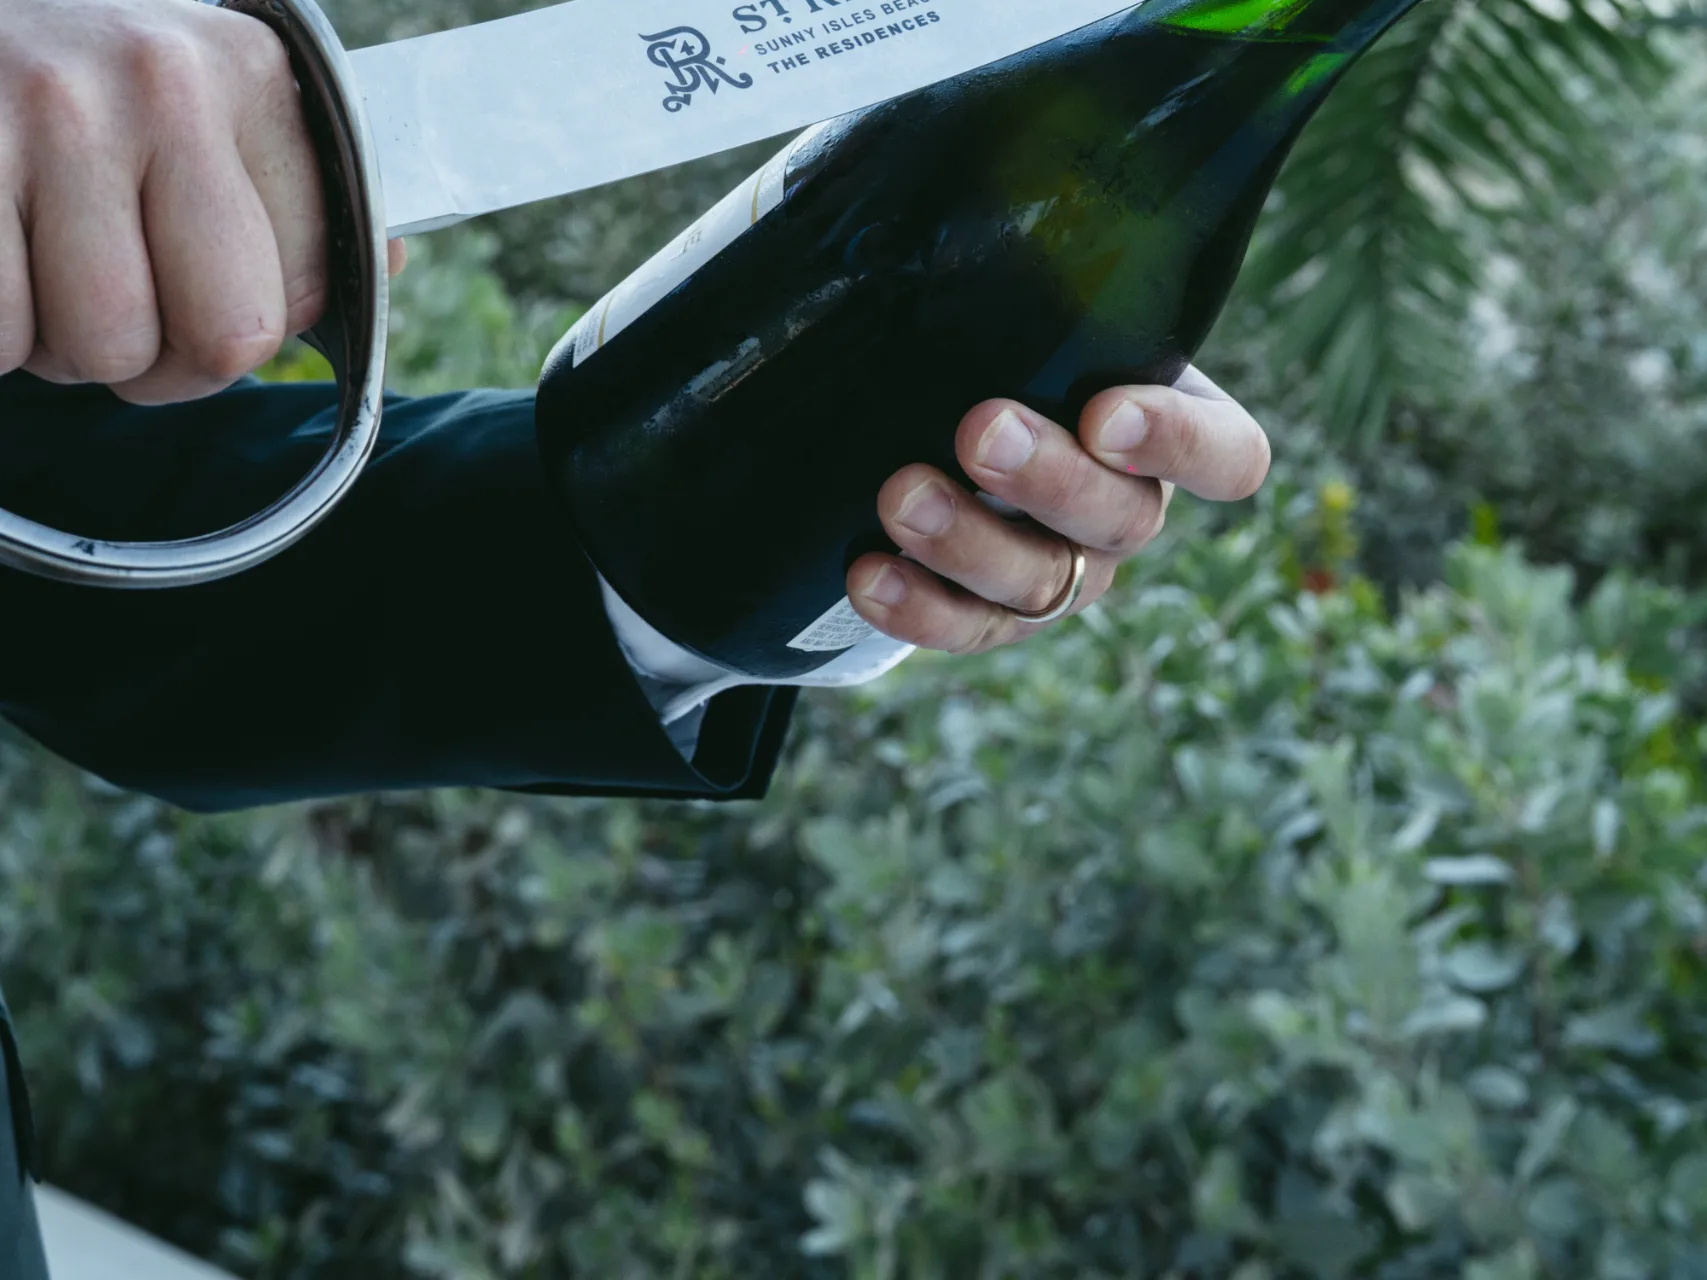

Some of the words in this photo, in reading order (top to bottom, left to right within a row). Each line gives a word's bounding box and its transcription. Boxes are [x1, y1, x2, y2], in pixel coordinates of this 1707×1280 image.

[754, 26, 816, 56] SUNNY
[821, 8, 876, 34] ISLES
[766, 52, 810, 74] THE
[814, 10, 941, 60] RESIDENCES
